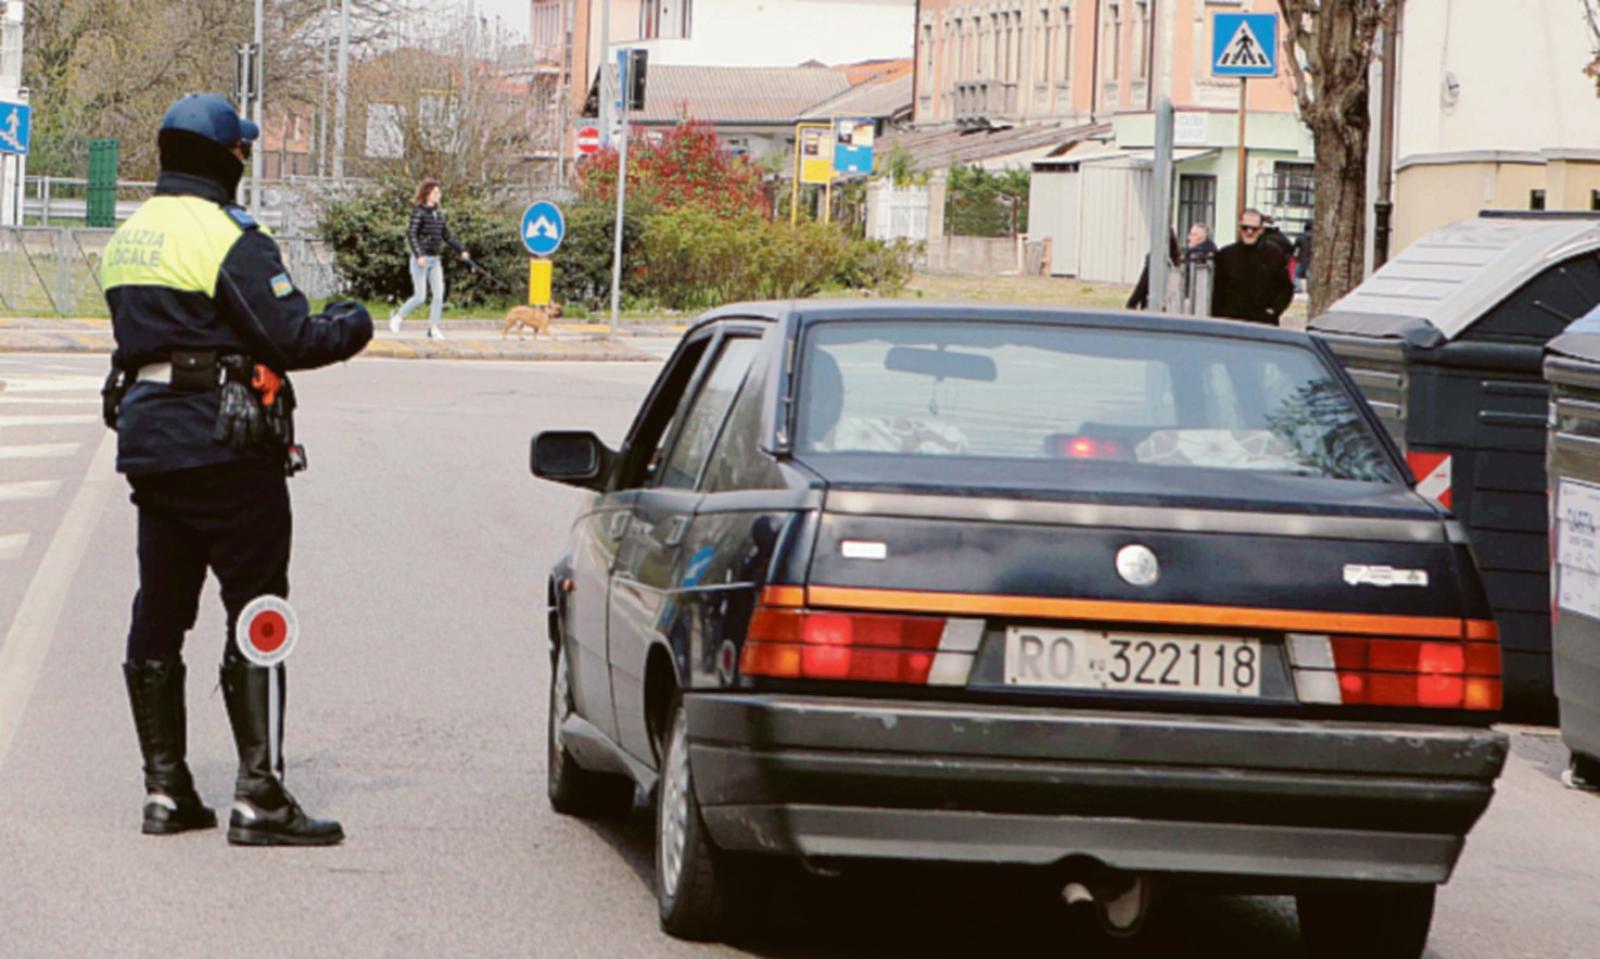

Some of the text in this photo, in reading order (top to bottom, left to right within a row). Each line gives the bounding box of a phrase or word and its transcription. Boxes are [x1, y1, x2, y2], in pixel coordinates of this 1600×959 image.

[114, 228, 165, 248] OLIZIA
[1017, 635, 1075, 680] RO
[1109, 639, 1256, 688] 322118
